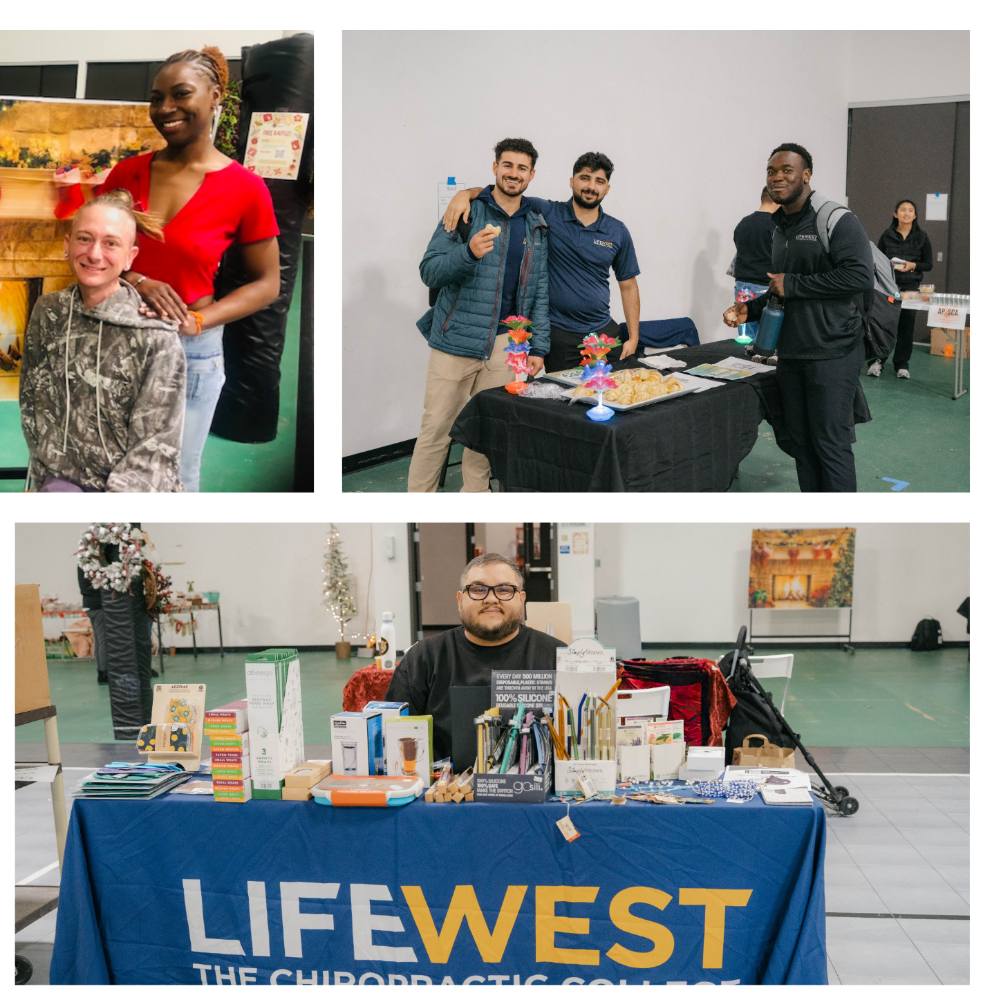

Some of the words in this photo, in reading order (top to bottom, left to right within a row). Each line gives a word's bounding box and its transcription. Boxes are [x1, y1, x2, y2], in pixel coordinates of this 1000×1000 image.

[495, 693, 517, 702] 100%
[518, 693, 552, 702] SILICONE
[261, 748, 267, 756] 3
[182, 879, 753, 969] LIFEWEST
